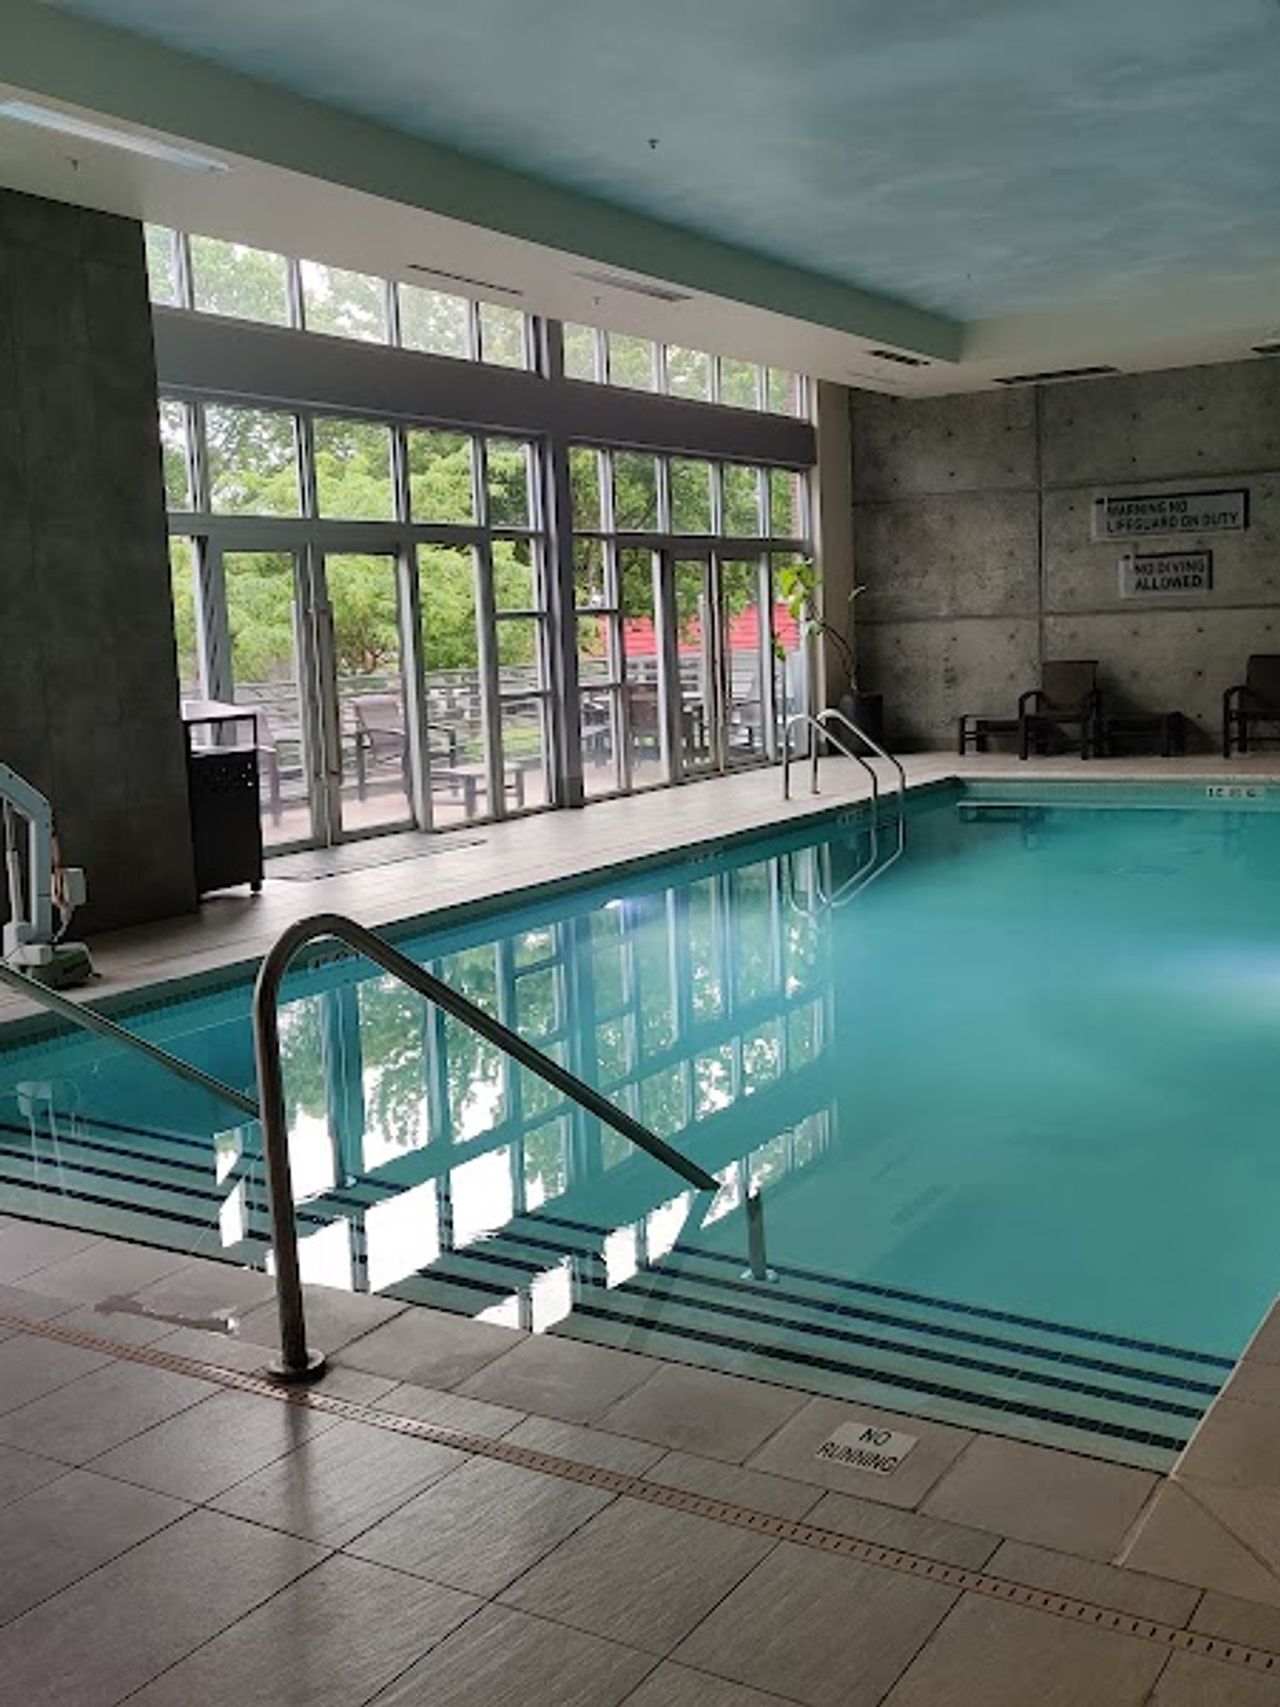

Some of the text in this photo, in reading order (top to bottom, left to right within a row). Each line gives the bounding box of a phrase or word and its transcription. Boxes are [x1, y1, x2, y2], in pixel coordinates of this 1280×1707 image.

[1169, 500, 1188, 513] NO
[1181, 515, 1199, 528] ON
[1202, 512, 1239, 527] DUTY
[1135, 559, 1205, 576] NO DIVING
[1135, 575, 1202, 590] ALLOWED
[859, 1428, 892, 1446] NO
[816, 1442, 898, 1472] RUNNING
